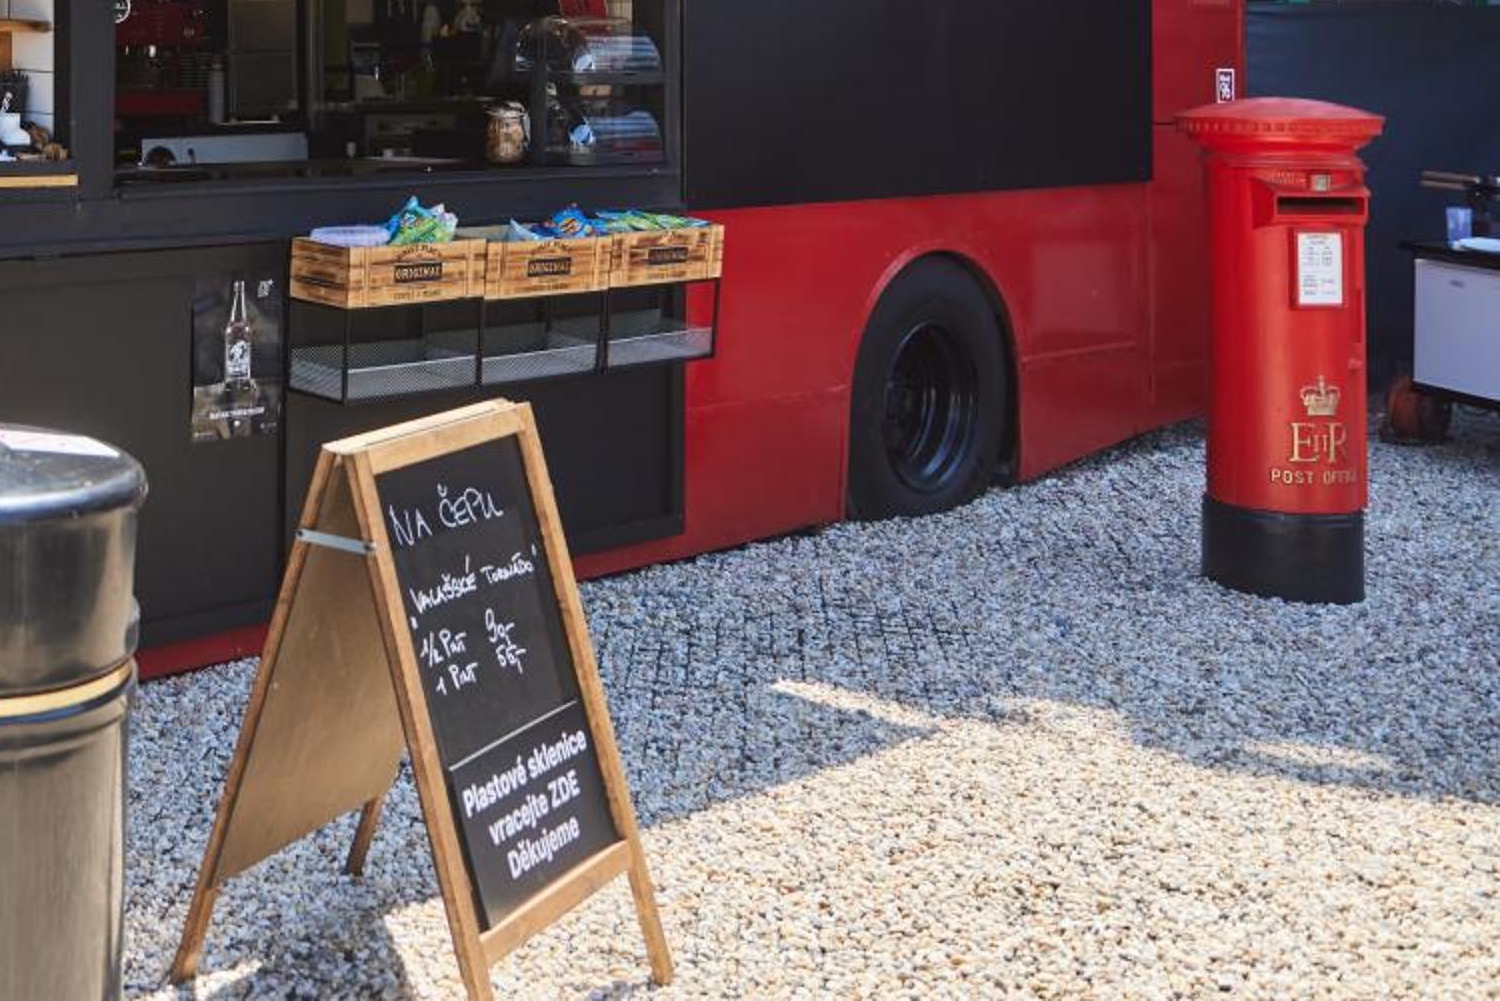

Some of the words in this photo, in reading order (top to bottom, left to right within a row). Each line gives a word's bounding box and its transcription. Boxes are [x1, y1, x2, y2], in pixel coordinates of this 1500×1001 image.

[1271, 468, 1314, 485] POST
[389, 504, 433, 546] NA
[436, 483, 505, 528] ČEPU
[461, 755, 528, 819] Plastové
[526, 729, 588, 779] sklenice
[488, 793, 550, 846] vracejte
[546, 768, 581, 809] ZDE
[506, 816, 581, 880] Děkujeme
